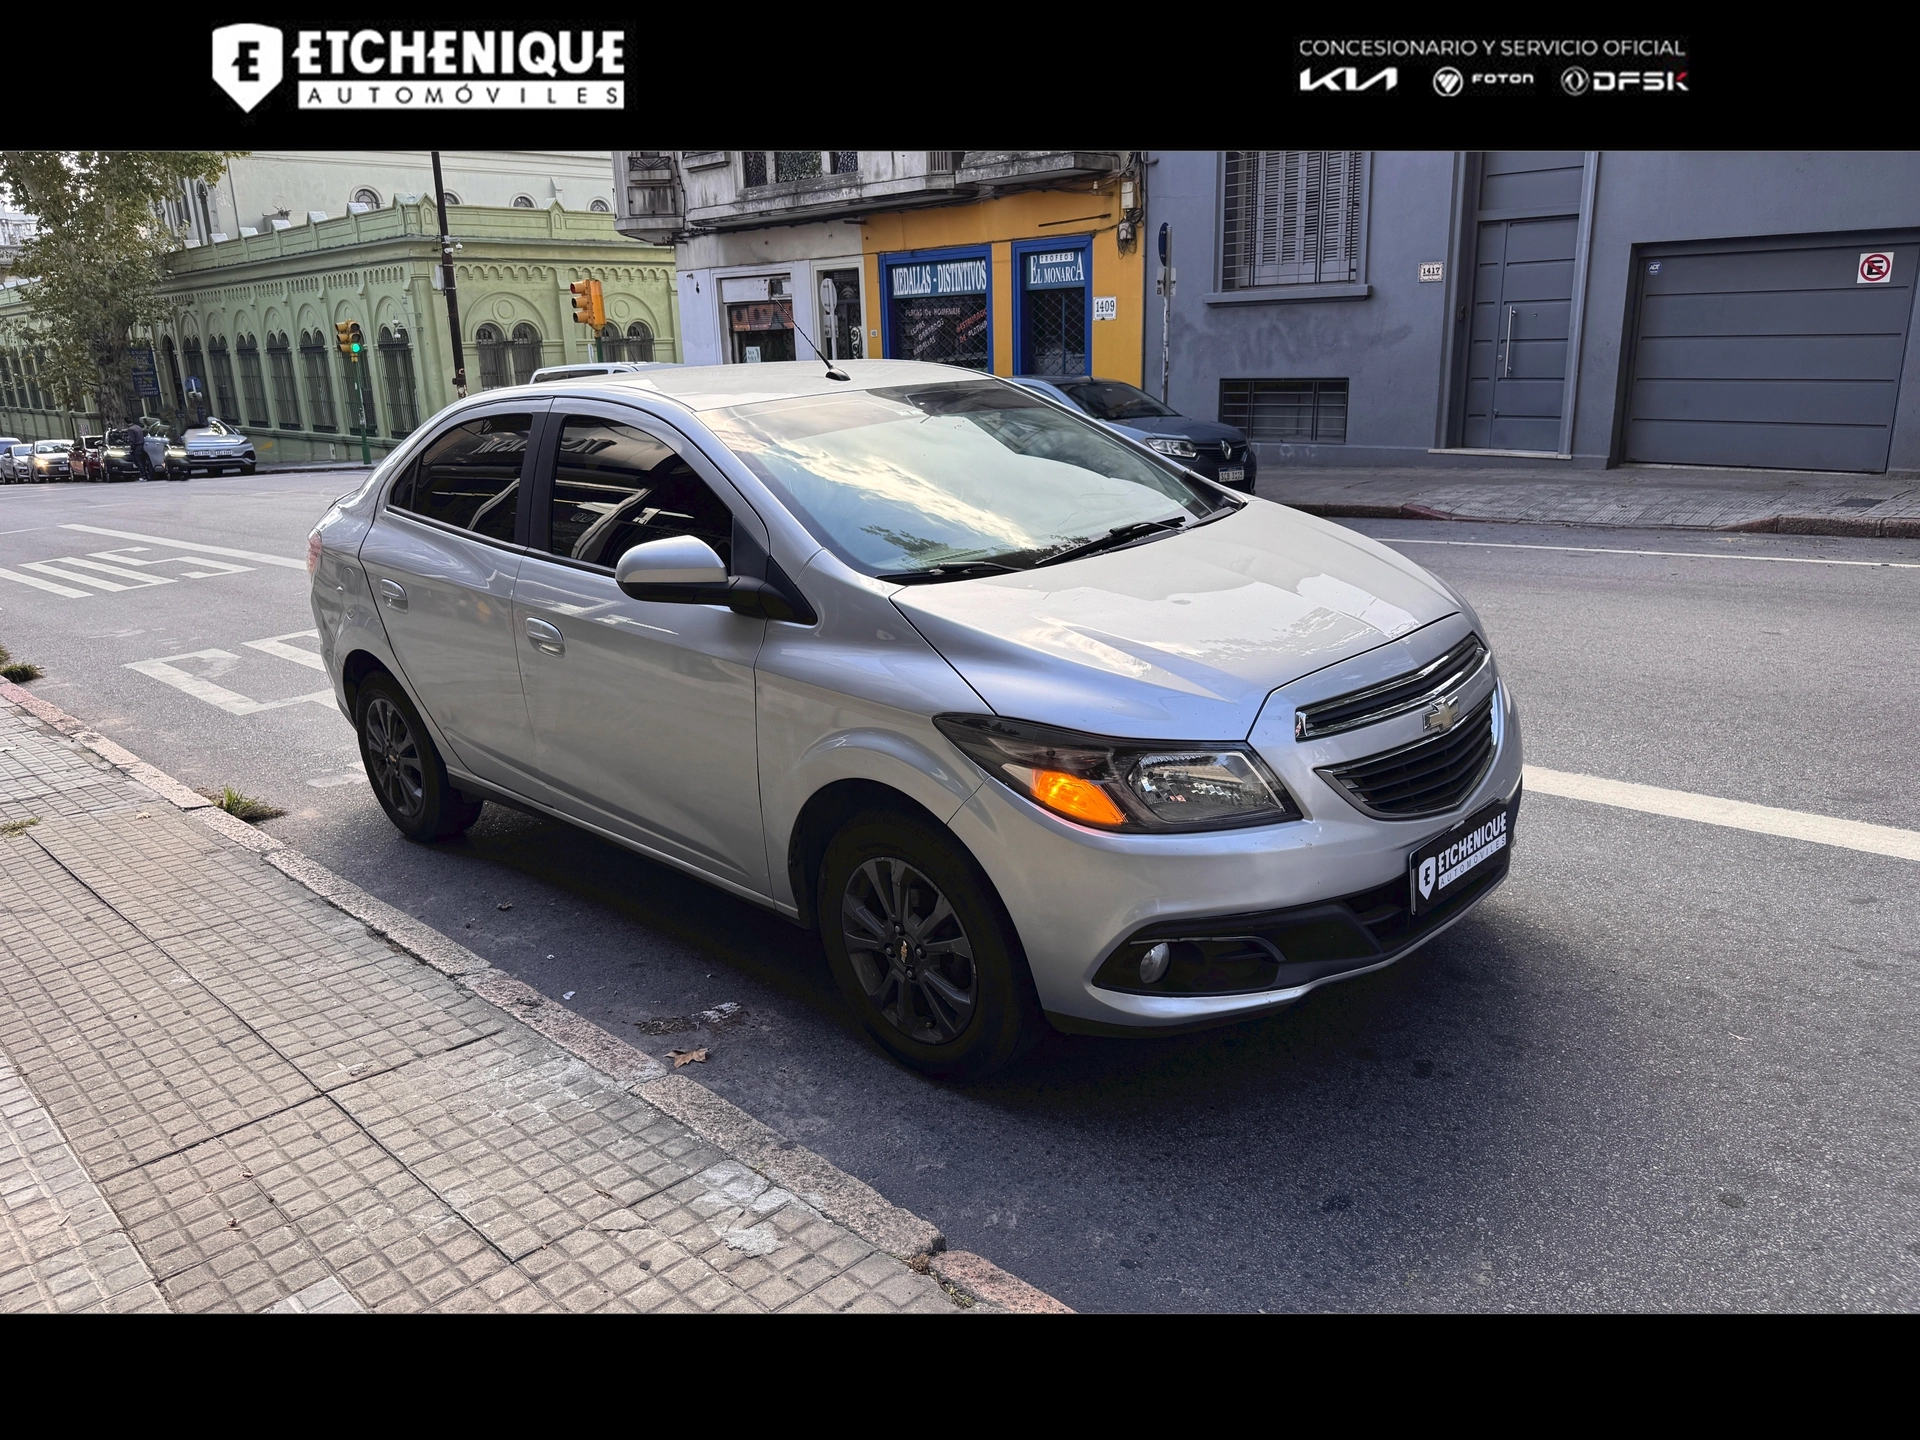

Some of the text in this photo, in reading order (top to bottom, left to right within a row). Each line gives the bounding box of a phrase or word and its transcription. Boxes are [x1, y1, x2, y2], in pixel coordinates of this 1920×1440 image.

[1041, 253, 1073, 262] TROFEOS
[1044, 252, 1084, 283] MONARCA
[892, 265, 932, 296] MEDALLAS
[937, 260, 987, 293] DISTINTIVOS
[1096, 300, 1115, 313] 1409
[1438, 811, 1507, 875] ETCHENIQUE
